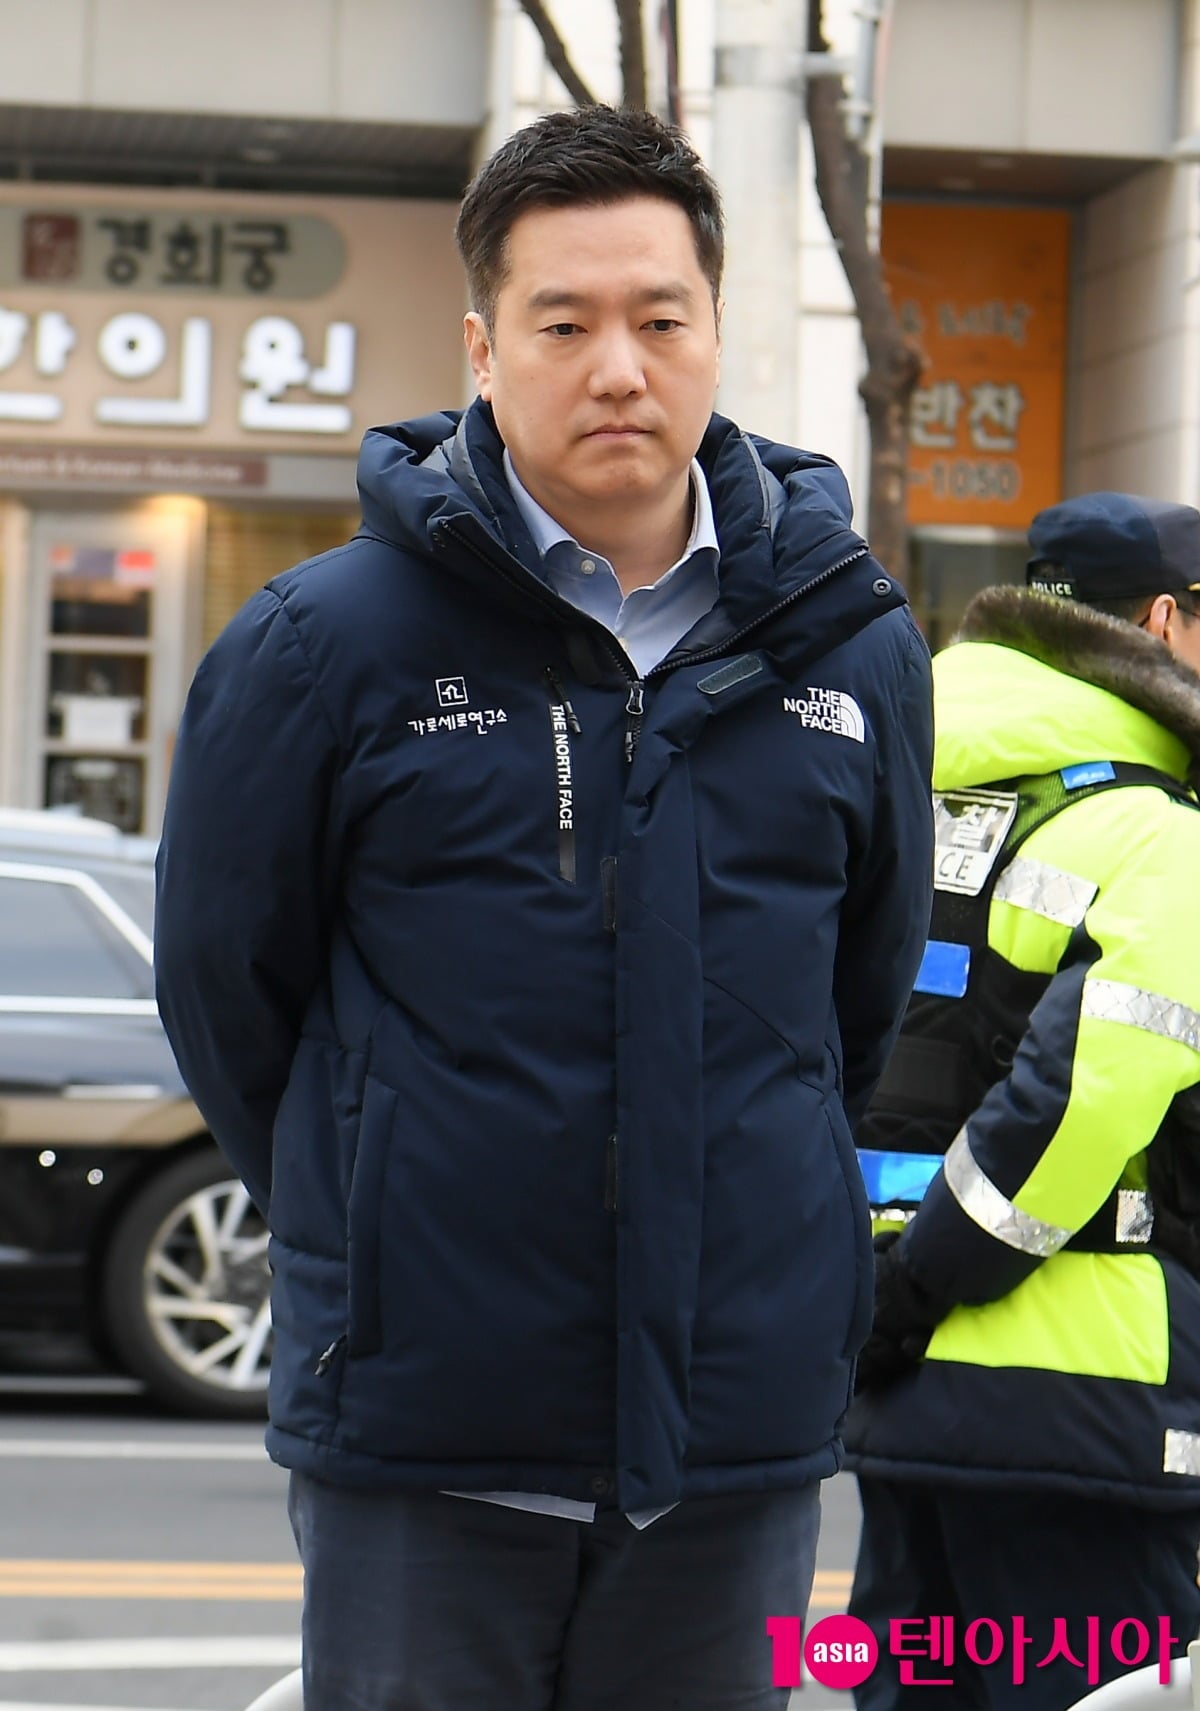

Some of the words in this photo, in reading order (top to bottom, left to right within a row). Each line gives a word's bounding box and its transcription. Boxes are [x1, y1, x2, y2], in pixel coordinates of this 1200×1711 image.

[97, 218, 292, 295] 경희궁
[1032, 581, 1073, 596] POLICE
[783, 697, 841, 719] NORTH
[807, 687, 841, 706] THE
[407, 708, 508, 735] 가로세로연구소
[551, 704, 567, 731] THE
[801, 714, 842, 734] FACE
[555, 734, 571, 786] NORTH
[559, 789, 572, 830] FACE
